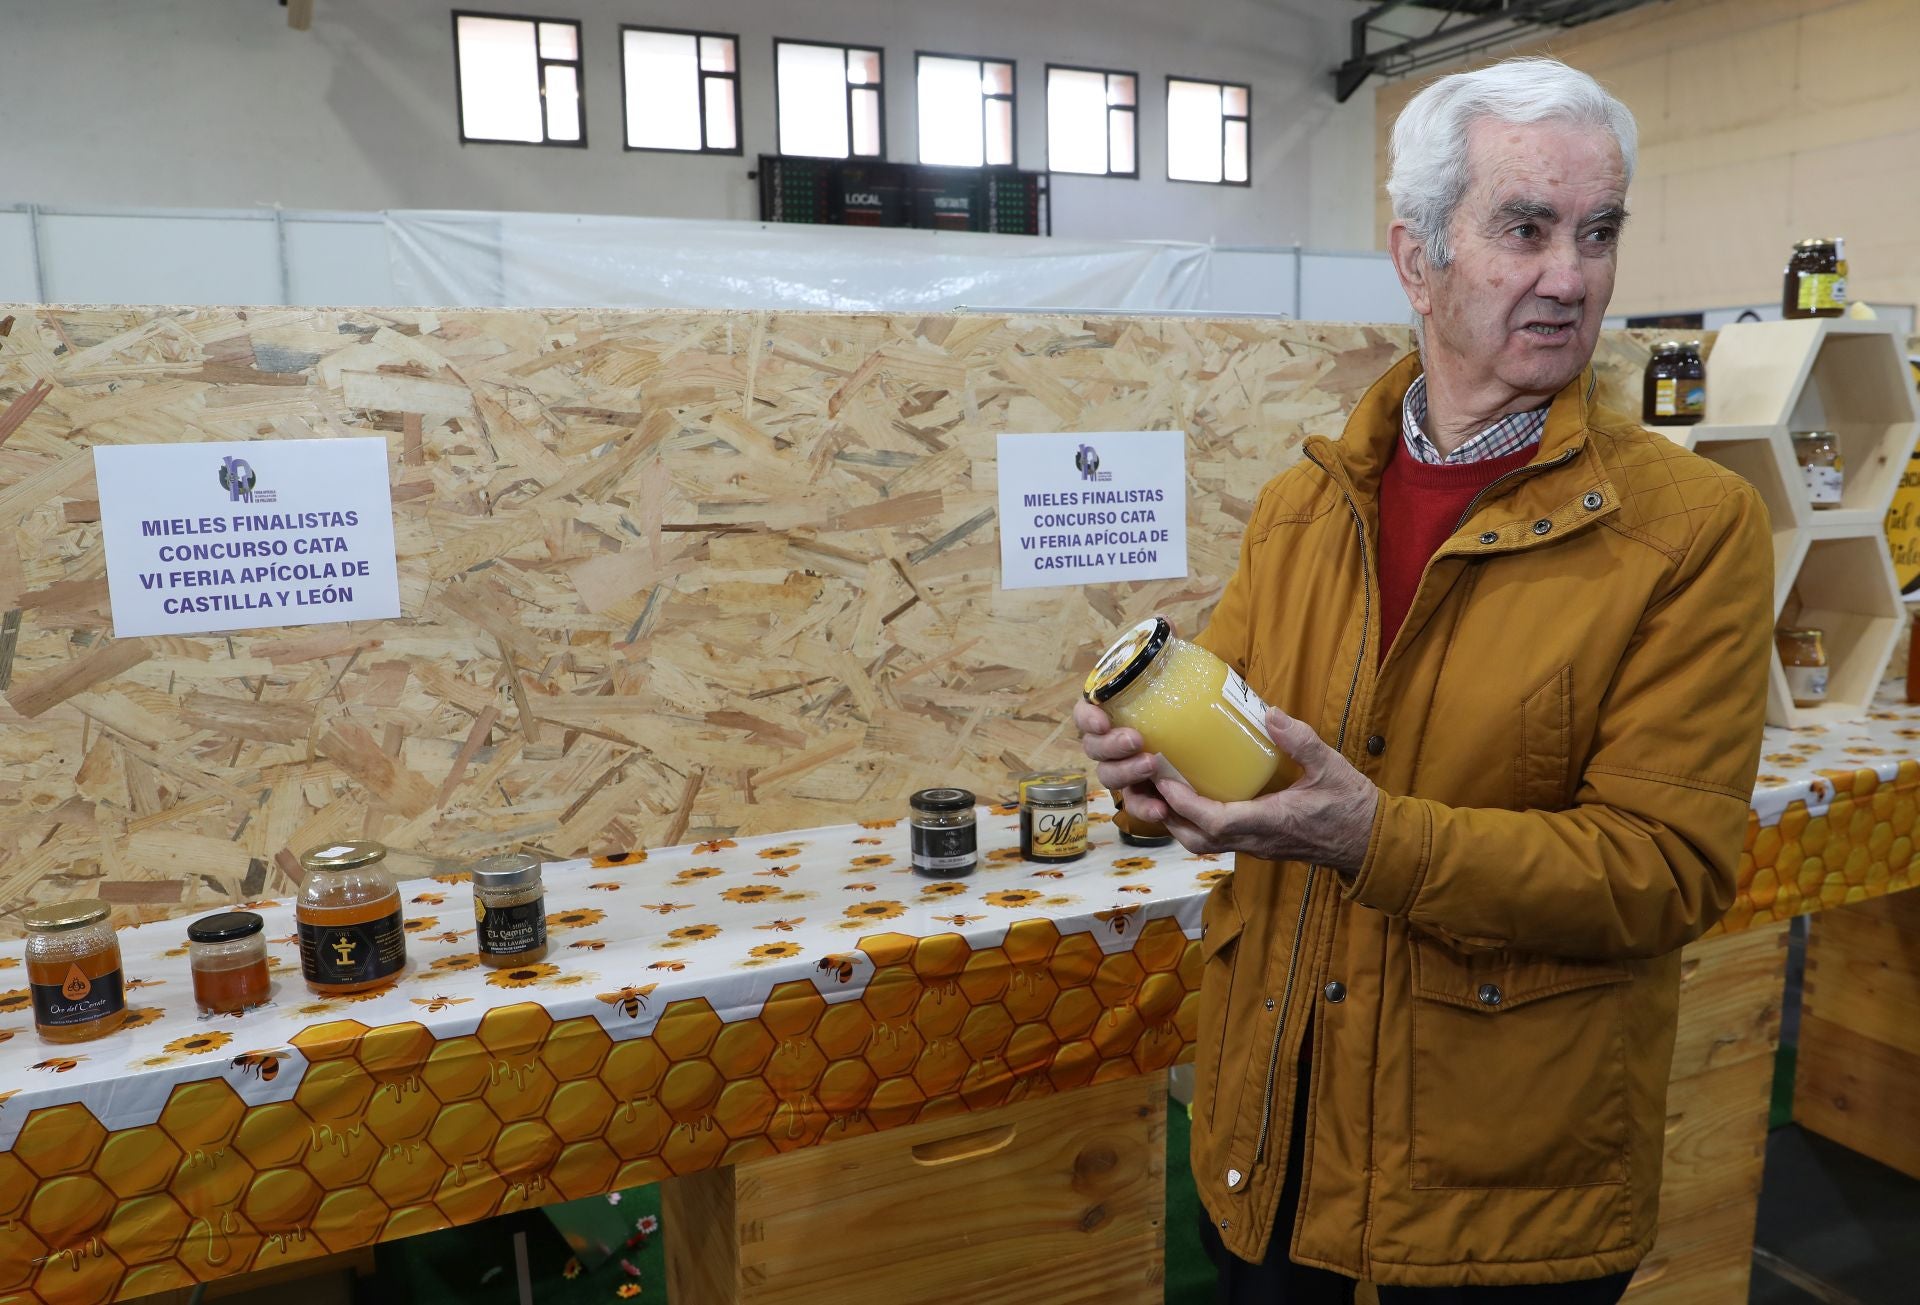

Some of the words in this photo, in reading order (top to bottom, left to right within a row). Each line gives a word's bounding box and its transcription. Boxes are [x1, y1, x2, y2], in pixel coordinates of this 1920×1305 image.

[844, 192, 882, 206] LOCAL
[1023, 492, 1079, 507] MIELES
[1082, 488, 1164, 505] FINALISTAS
[141, 516, 227, 537] MIELES
[233, 510, 359, 532] FINALISTAS
[1033, 511, 1117, 528] CONCURSO
[1120, 509, 1156, 523] CATA
[158, 539, 288, 563] CONCURSO
[293, 536, 348, 555] CATA
[1020, 536, 1036, 550] VI
[1039, 534, 1082, 549] FERIA
[1084, 529, 1148, 546] APÍCOLA
[1150, 529, 1169, 542] DE
[1034, 553, 1105, 570] CASTILLA
[1106, 552, 1116, 565] Y
[1119, 547, 1158, 565] LEÓN
[138, 572, 164, 590] VI
[169, 568, 236, 588] FERIA
[239, 561, 338, 583] APÍCOLA
[341, 560, 370, 577] DE
[162, 591, 274, 615] CASTILLA
[276, 590, 291, 607] Y
[296, 584, 354, 606] LEÓN
